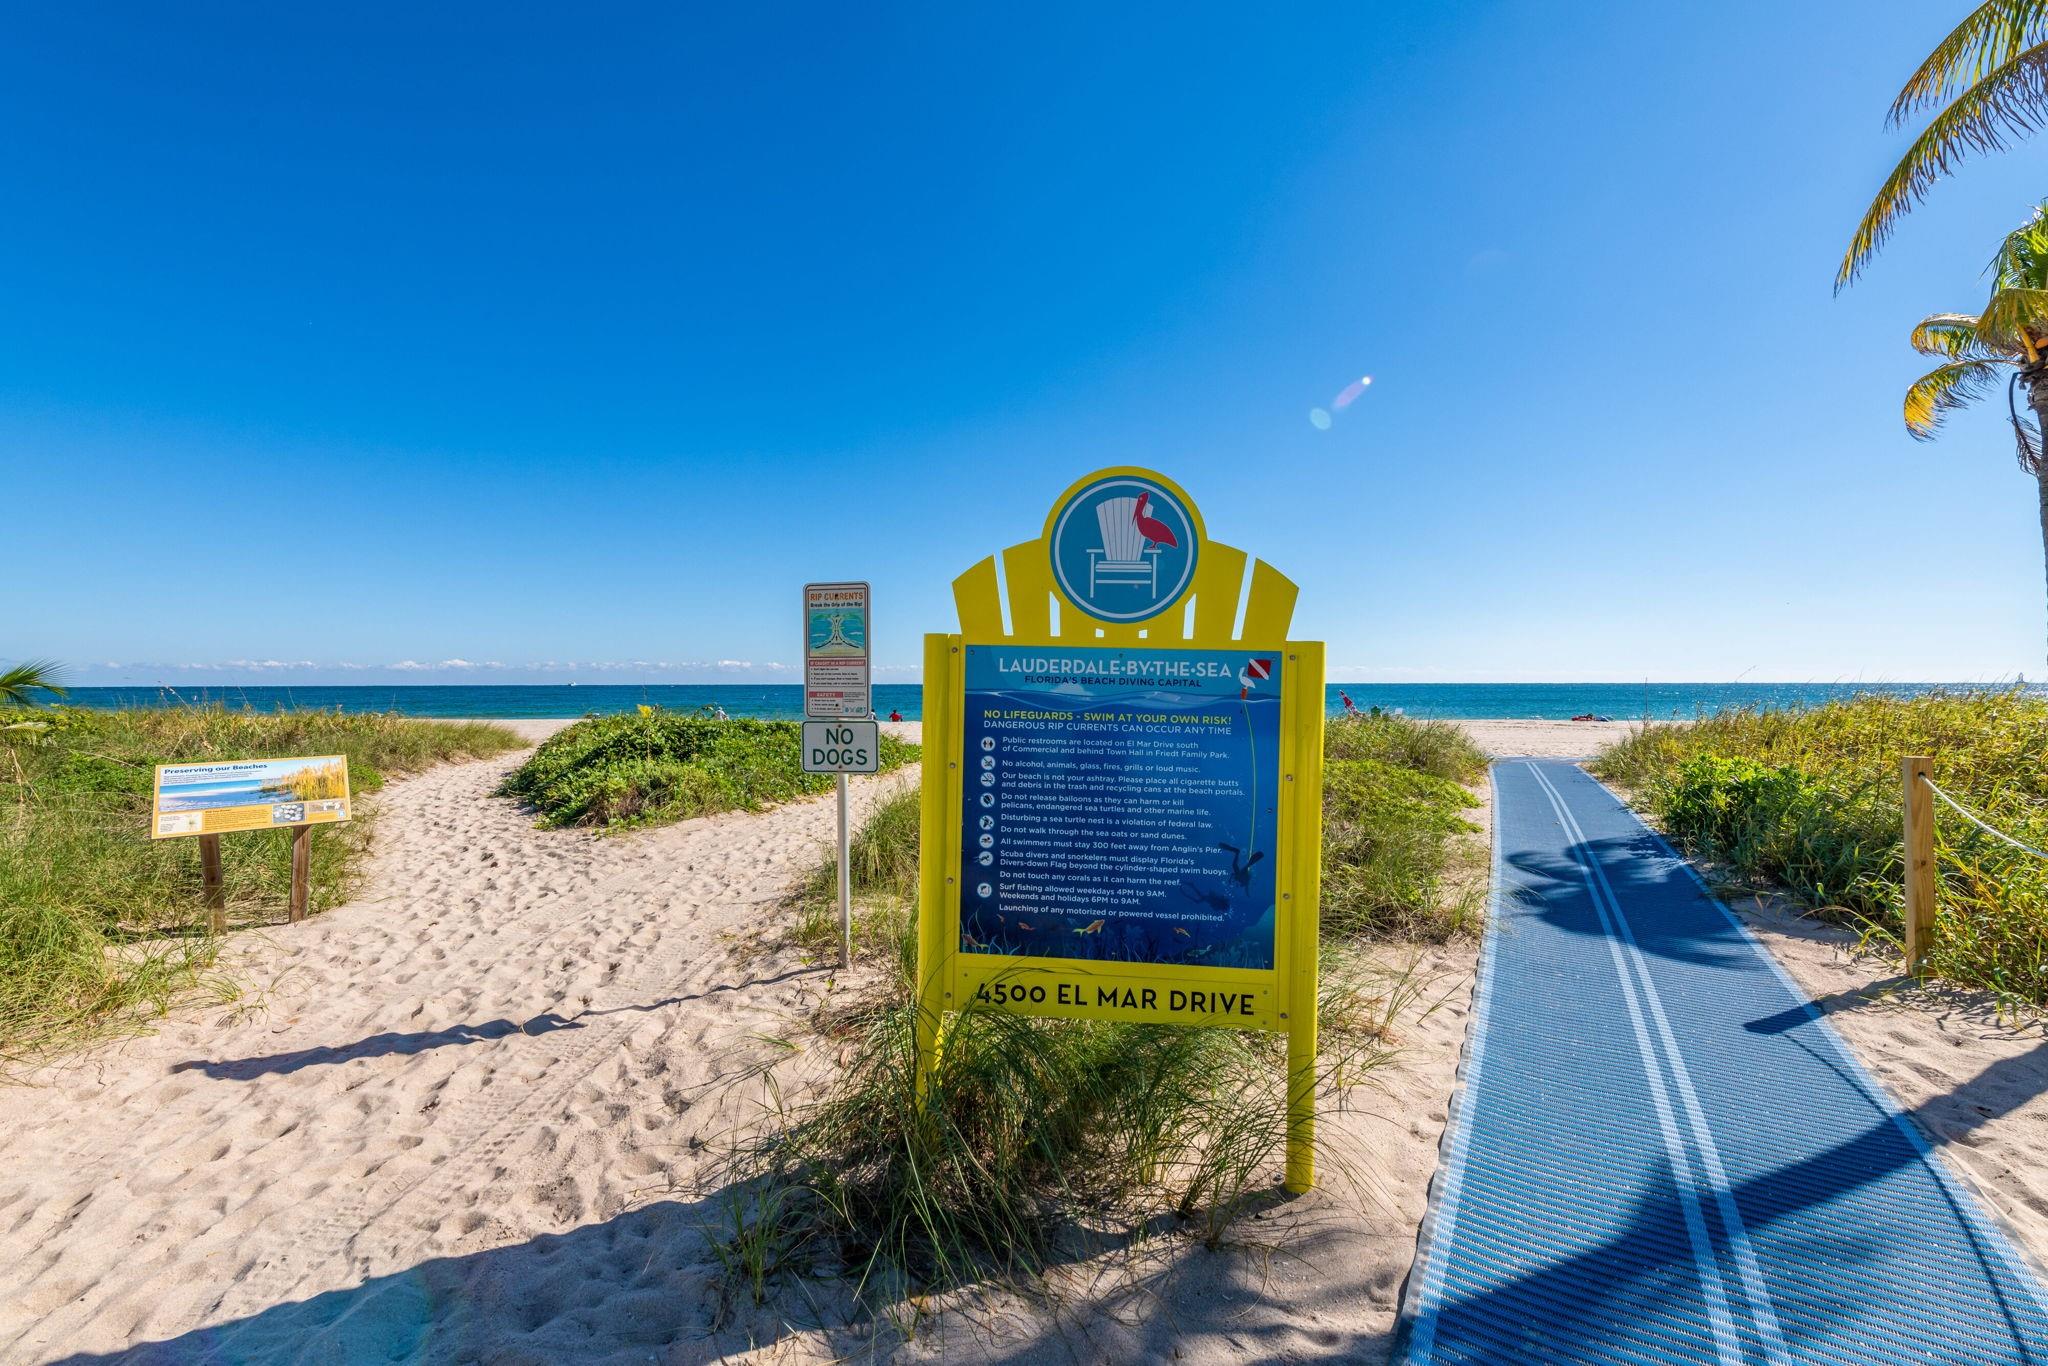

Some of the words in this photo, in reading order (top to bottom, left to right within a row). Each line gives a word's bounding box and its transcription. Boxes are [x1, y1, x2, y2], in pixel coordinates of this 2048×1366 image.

[1025, 675, 1078, 684] FLORIDA'S
[1080, 677, 1115, 685] BEACH
[1119, 678, 1155, 686] DIVING
[1158, 679, 1201, 687] CAPITAL
[984, 710, 1000, 718] NO
[1004, 711, 1073, 720] LIFEGUARDS
[1084, 713, 1114, 721] SWIM
[1136, 714, 1166, 722] YOUR
[1170, 715, 1198, 723] OWN
[1202, 716, 1232, 724] RISK!
[984, 721, 1045, 729] DANGEROUS
[1048, 722, 1063, 730] RIP
[1066, 723, 1118, 731] CURRENTS
[1122, 724, 1142, 732] CAN
[1146, 725, 1181, 733] OCCUR
[1185, 726, 1205, 734] ANY
[826, 728, 854, 744] NO
[813, 749, 868, 765] DOGS
[1181, 750, 1207, 759] Family
[1125, 764, 1143, 772] grills
[1146, 777, 1166, 786] place
[1180, 778, 1216, 787] cigarette
[1107, 784, 1141, 794] recycling
[1105, 797, 1121, 805] they
[1037, 803, 1082, 813] endangered
[1049, 828, 1079, 837] through
[1075, 841, 1090, 850] stay
[1068, 853, 1107, 861] snorkelers
[1131, 856, 1158, 865] display
[1000, 859, 1048, 867] Divers-down
[1050, 861, 1066, 870] Flag
[1069, 862, 1098, 871] beyond
[1115, 864, 1177, 874] cylinder-shaped
[1000, 904, 1038, 914] Launching
[1067, 907, 1106, 915] motorized
[1119, 910, 1153, 919] powered
[976, 983, 1046, 1004] 4500
[1057, 984, 1088, 1006] EL
[1098, 986, 1158, 1010] MAR
[1169, 990, 1255, 1016] DRIVE
